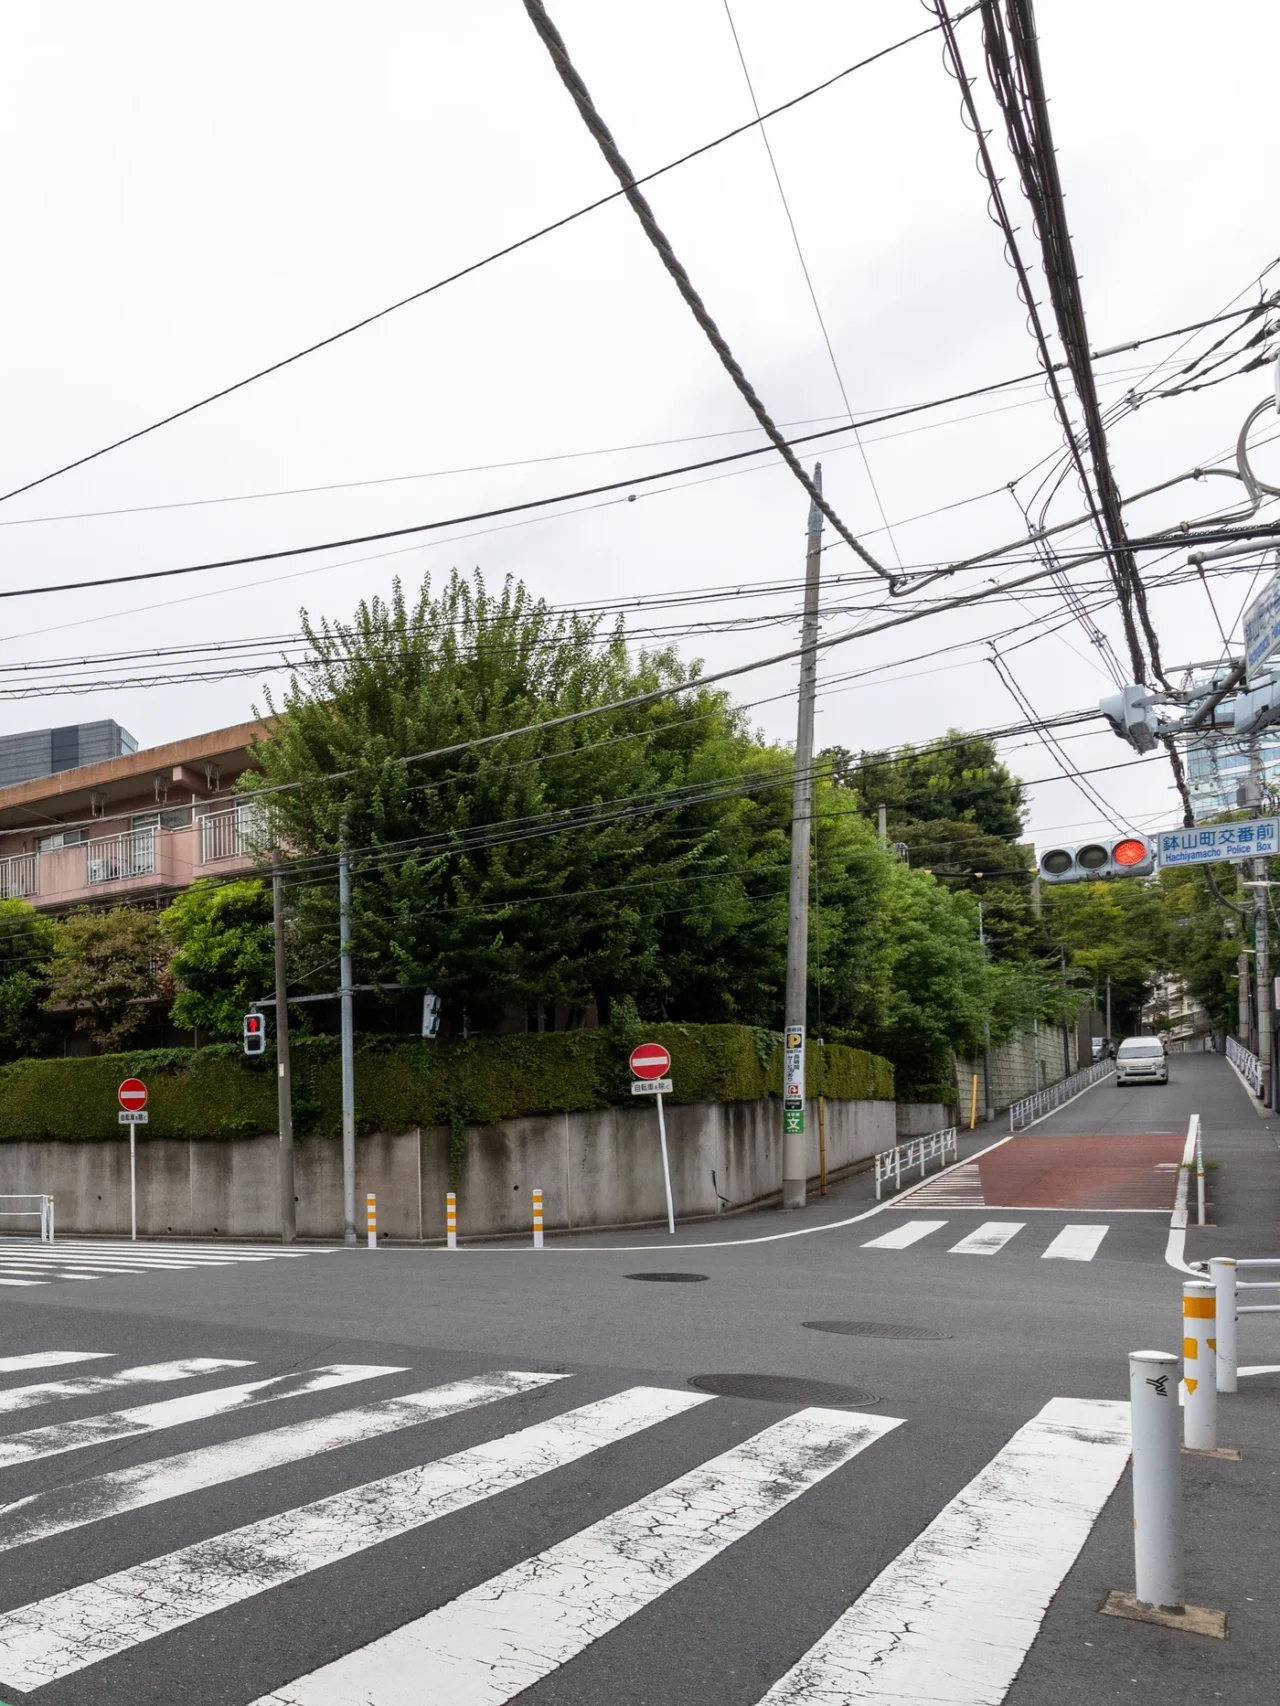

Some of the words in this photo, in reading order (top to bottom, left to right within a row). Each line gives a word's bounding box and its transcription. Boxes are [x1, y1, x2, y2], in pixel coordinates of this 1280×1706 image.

[1163, 823, 1274, 852] 鉢山町交番前
[1166, 848, 1221, 862] Hachiyamacho
[1226, 844, 1251, 855] Police
[1256, 841, 1272, 852] Box
[634, 1082, 670, 1093] 自転車を除く
